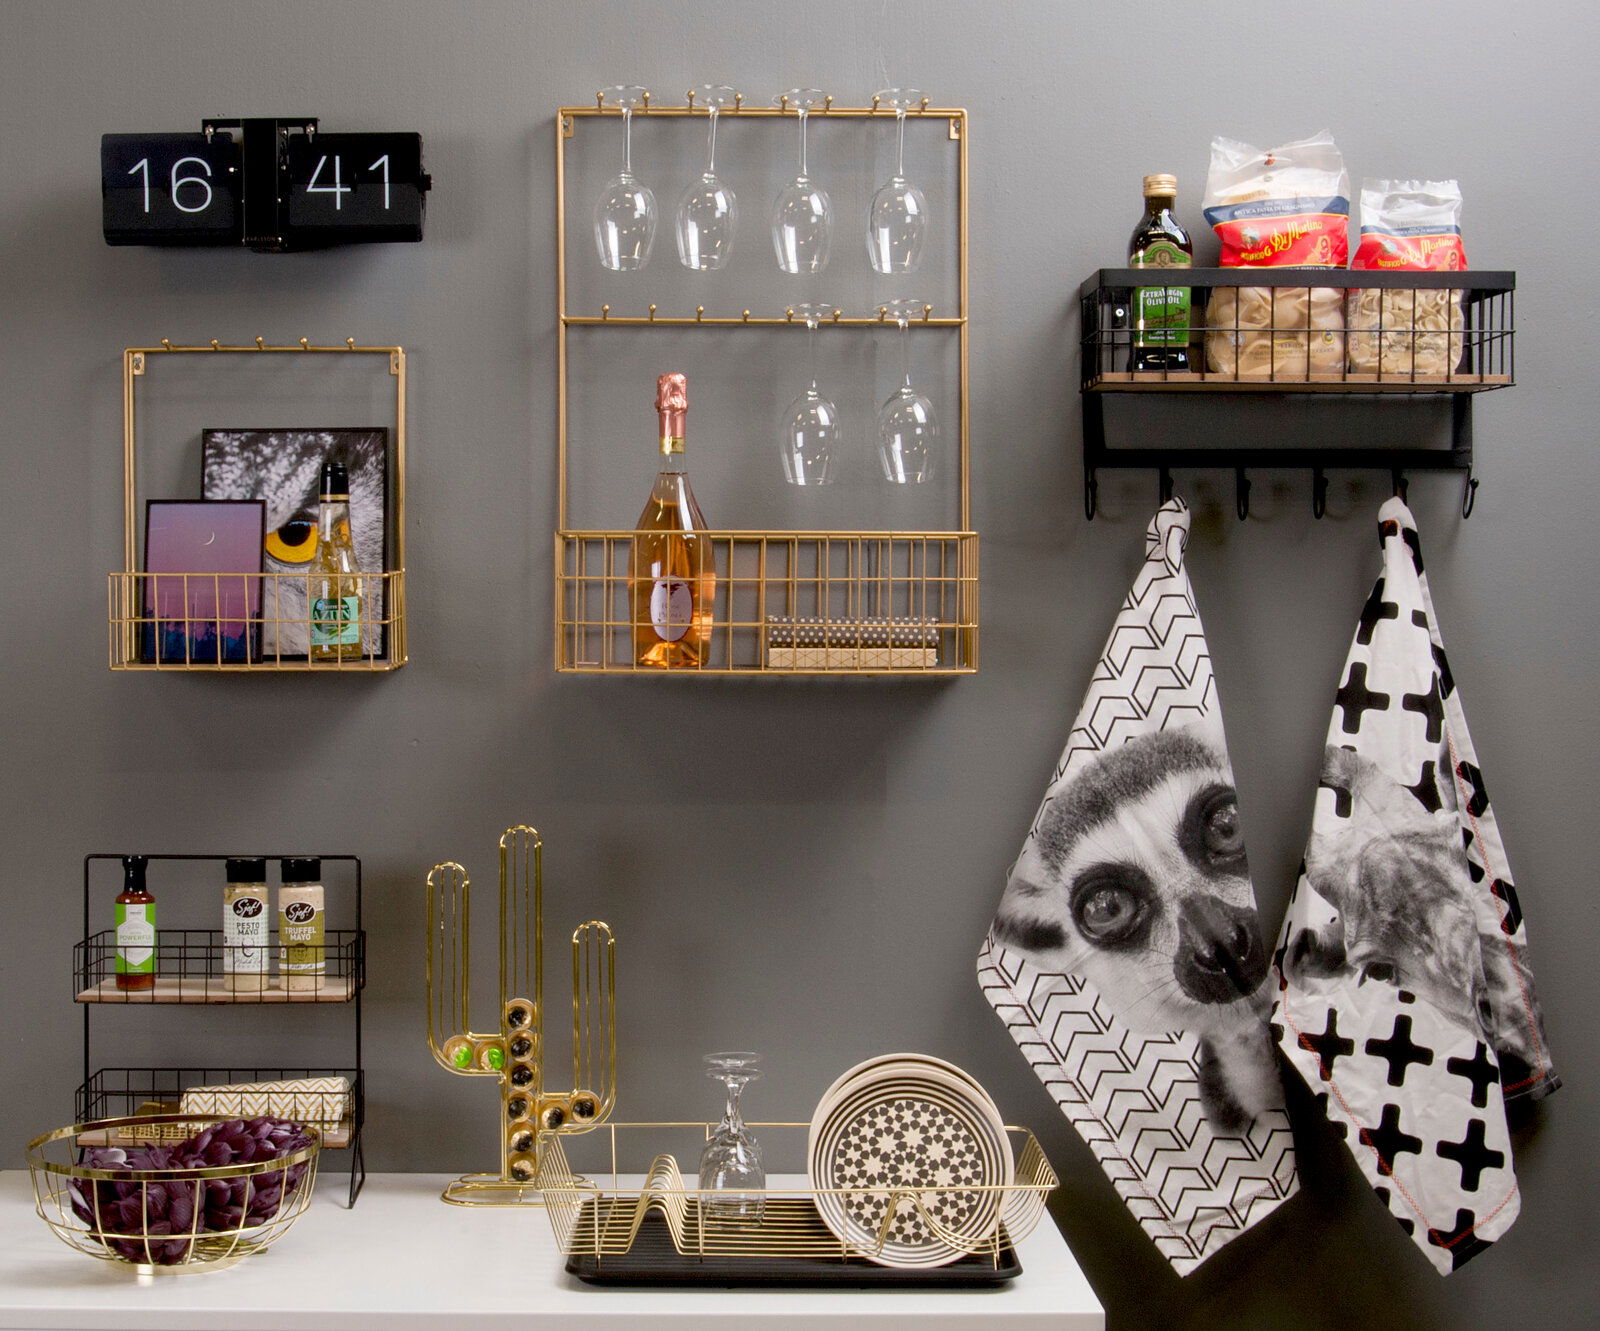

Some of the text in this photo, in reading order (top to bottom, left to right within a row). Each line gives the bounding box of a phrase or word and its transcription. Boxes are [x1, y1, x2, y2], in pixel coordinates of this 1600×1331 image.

[127, 154, 391, 214] 16 41
[1281, 220, 1323, 250] Martino
[1420, 238, 1454, 262] Martino
[1167, 296, 1180, 304] OIL
[284, 926, 316, 934] TRUFFEL
[290, 933, 311, 941] MAYO
